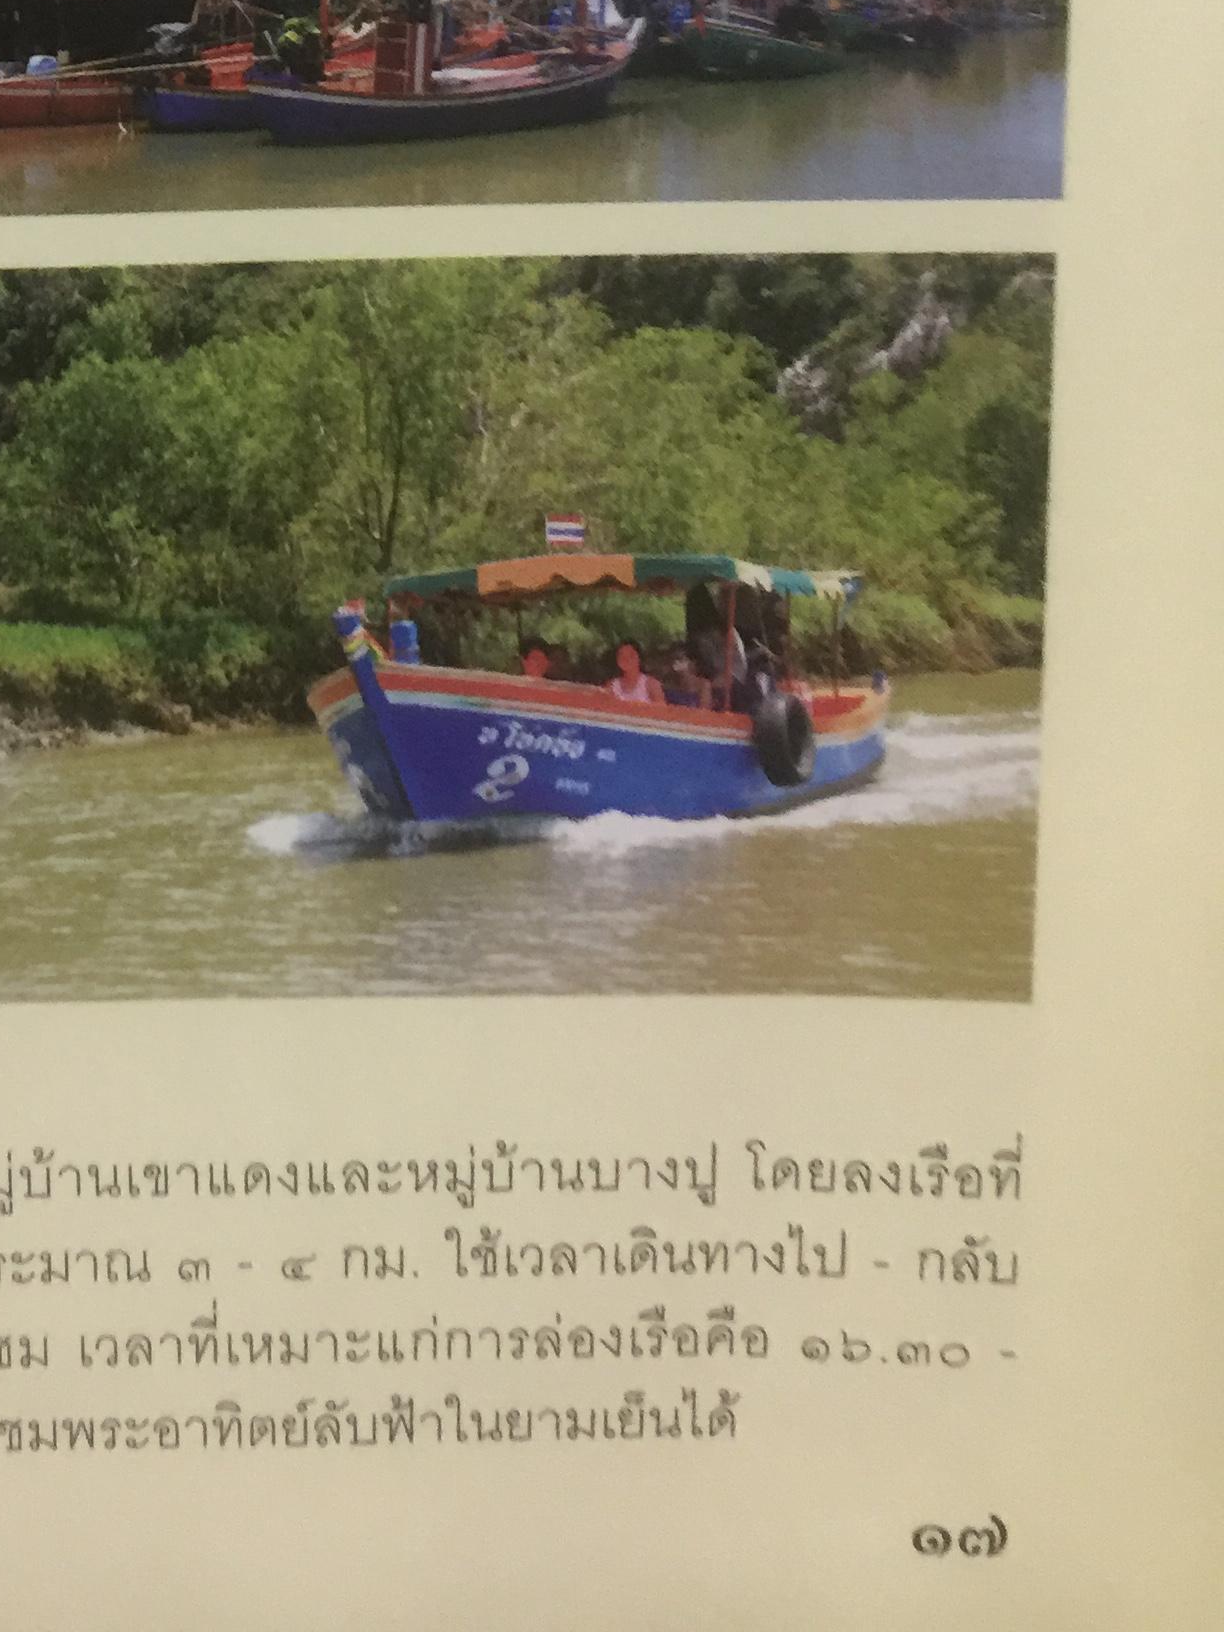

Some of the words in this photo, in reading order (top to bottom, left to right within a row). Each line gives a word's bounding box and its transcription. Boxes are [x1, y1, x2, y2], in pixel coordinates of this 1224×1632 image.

[744, 1131, 1024, 1201] โดยลงเรือที่
[177, 1257, 211, 1283] ๓
[280, 1254, 317, 1283] ๔
[342, 1244, 419, 1281] กม.
[443, 1222, 848, 1280] ใช้เวลาเดินทางไป
[917, 1234, 1019, 1286] กลับ
[80, 1298, 769, 1369] เวลาที่เหมาะแก่การล่องเรือคือ
[800, 1329, 971, 1370] ๑๖.๓๐
[910, 1512, 1009, 1559] ๑๗
